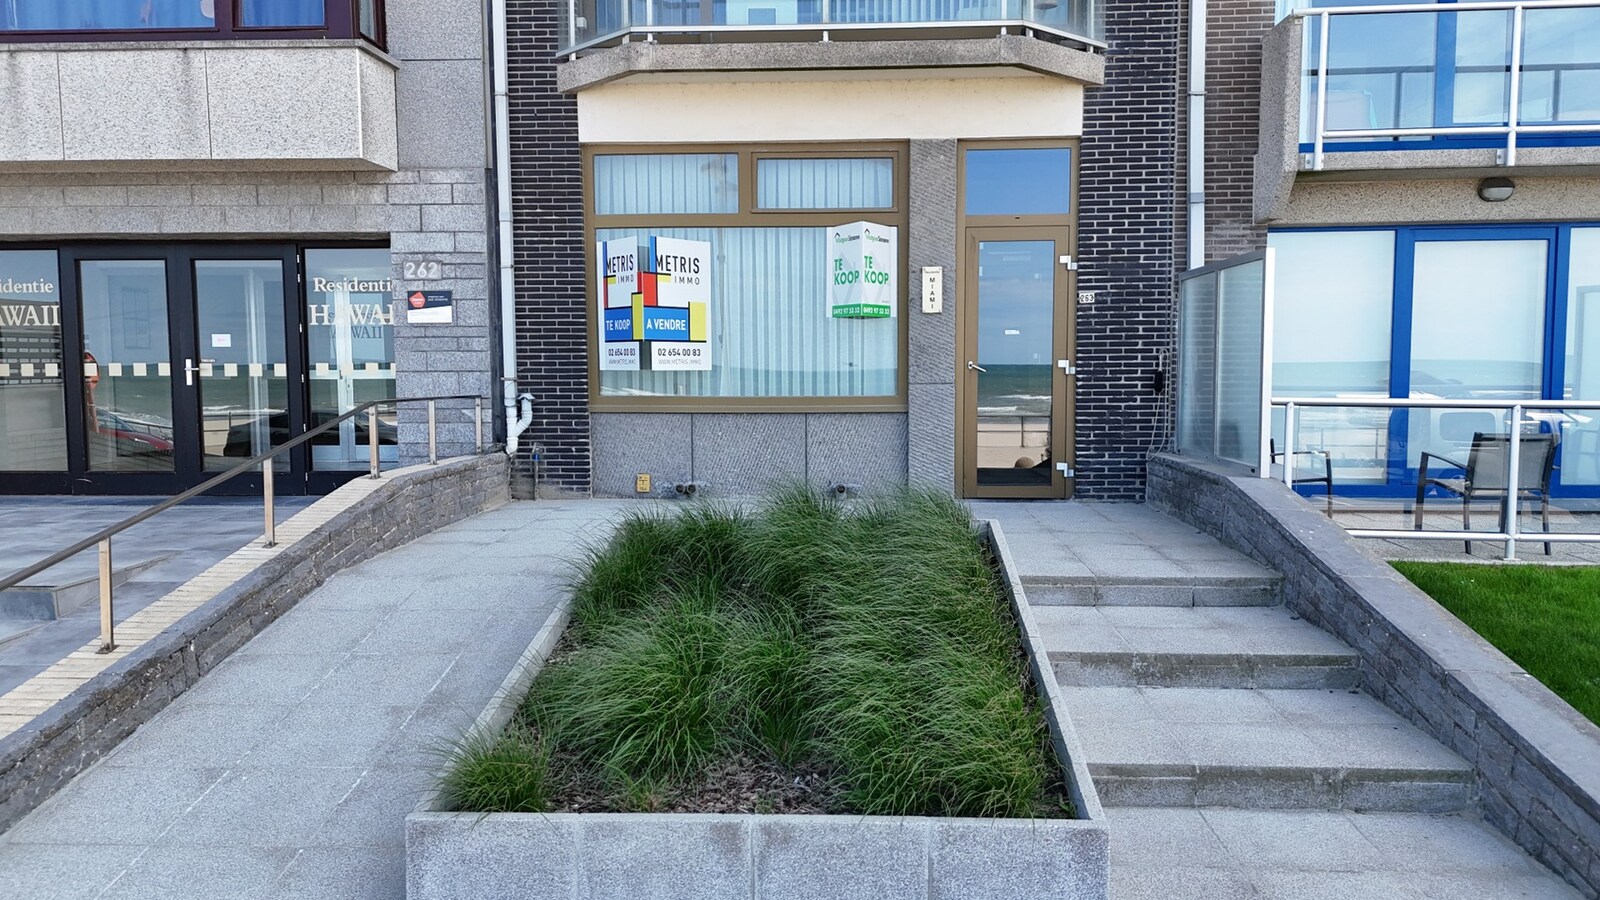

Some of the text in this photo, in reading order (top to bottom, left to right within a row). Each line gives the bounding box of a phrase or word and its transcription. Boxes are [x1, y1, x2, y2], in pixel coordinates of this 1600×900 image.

[606, 254, 634, 273] METRIS
[656, 254, 700, 274] METRIS
[834, 258, 843, 271] TE
[864, 255, 873, 269] TE
[405, 261, 438, 278] 262
[617, 274, 635, 284] IMMO
[674, 276, 700, 286] IMMO
[834, 271, 860, 285] KOOP
[864, 270, 889, 284] KOOP
[313, 277, 393, 292] Residenti
[1080, 294, 1094, 302] 263
[309, 304, 394, 325] HWAI
[606, 319, 631, 331] TE KOOP
[646, 318, 686, 330] A VENDRE
[608, 348, 636, 356] 02 654 00 83
[658, 348, 701, 357] 02 654 00 83
